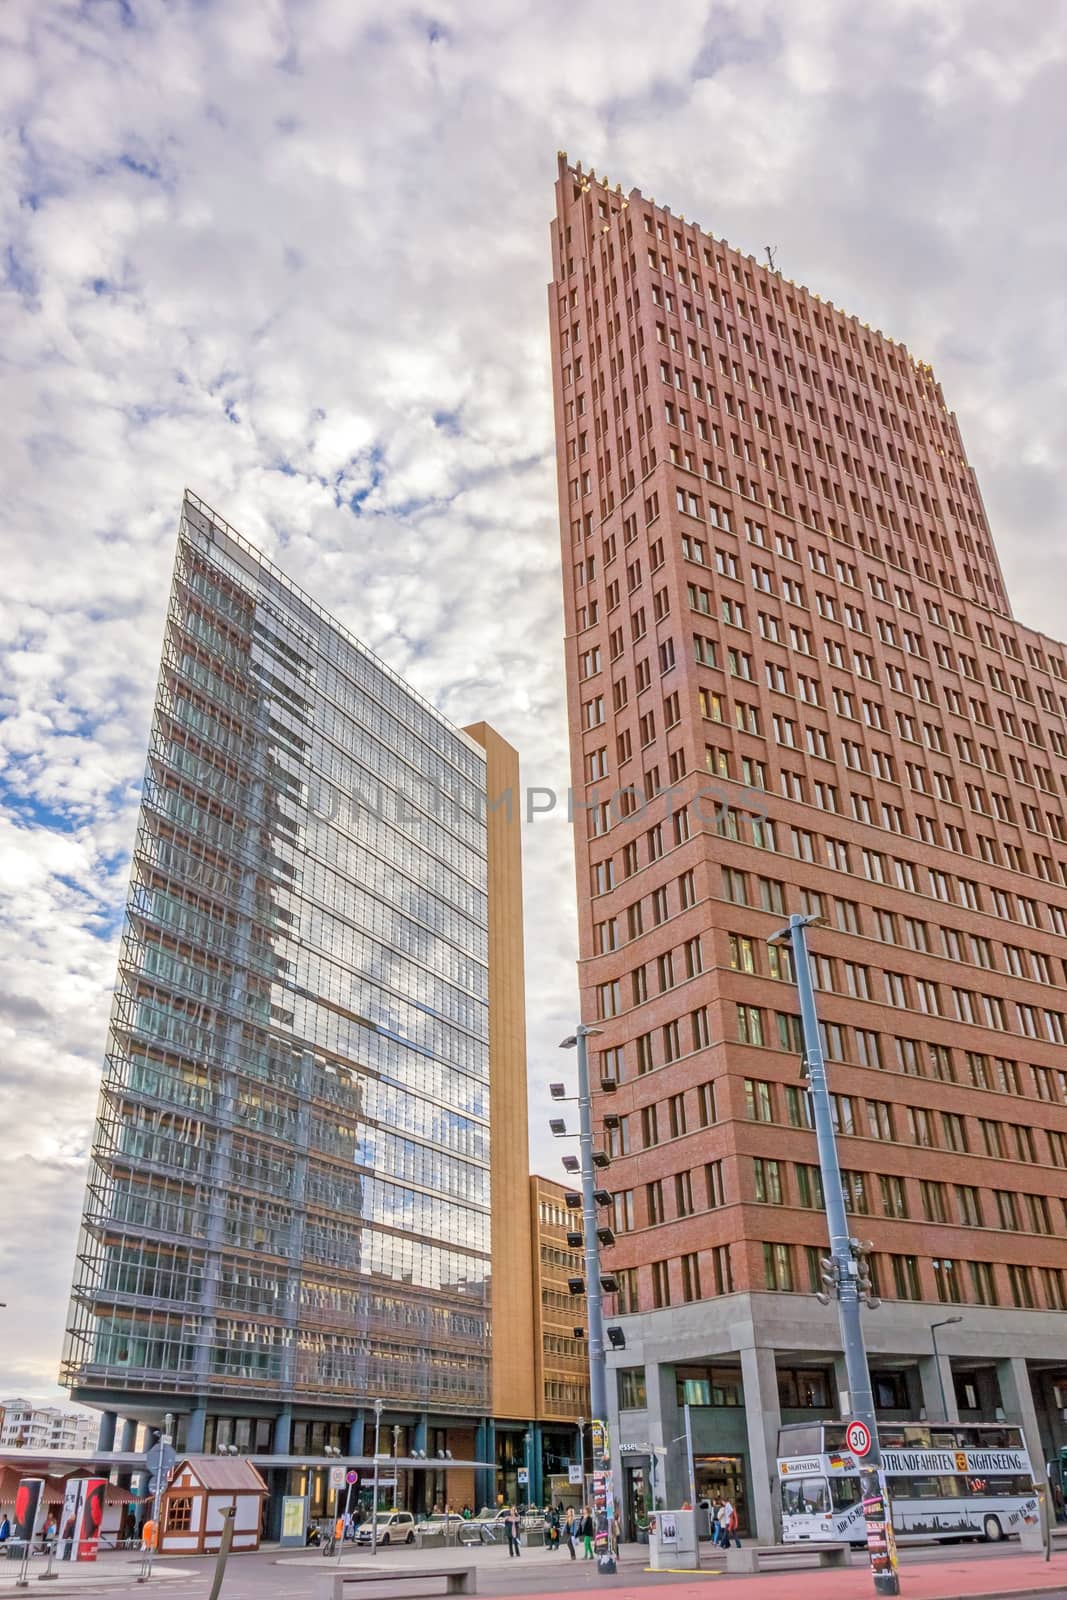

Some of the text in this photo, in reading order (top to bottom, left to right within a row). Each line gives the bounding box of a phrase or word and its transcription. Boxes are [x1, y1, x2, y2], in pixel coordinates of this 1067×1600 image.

[851, 1431, 866, 1447] 30
[788, 1461, 820, 1472] SIGHTSEEING
[967, 1452, 1022, 1471] SIGHTSEEING
[836, 1519, 849, 1534] Alle
[847, 1511, 856, 1525] 15
